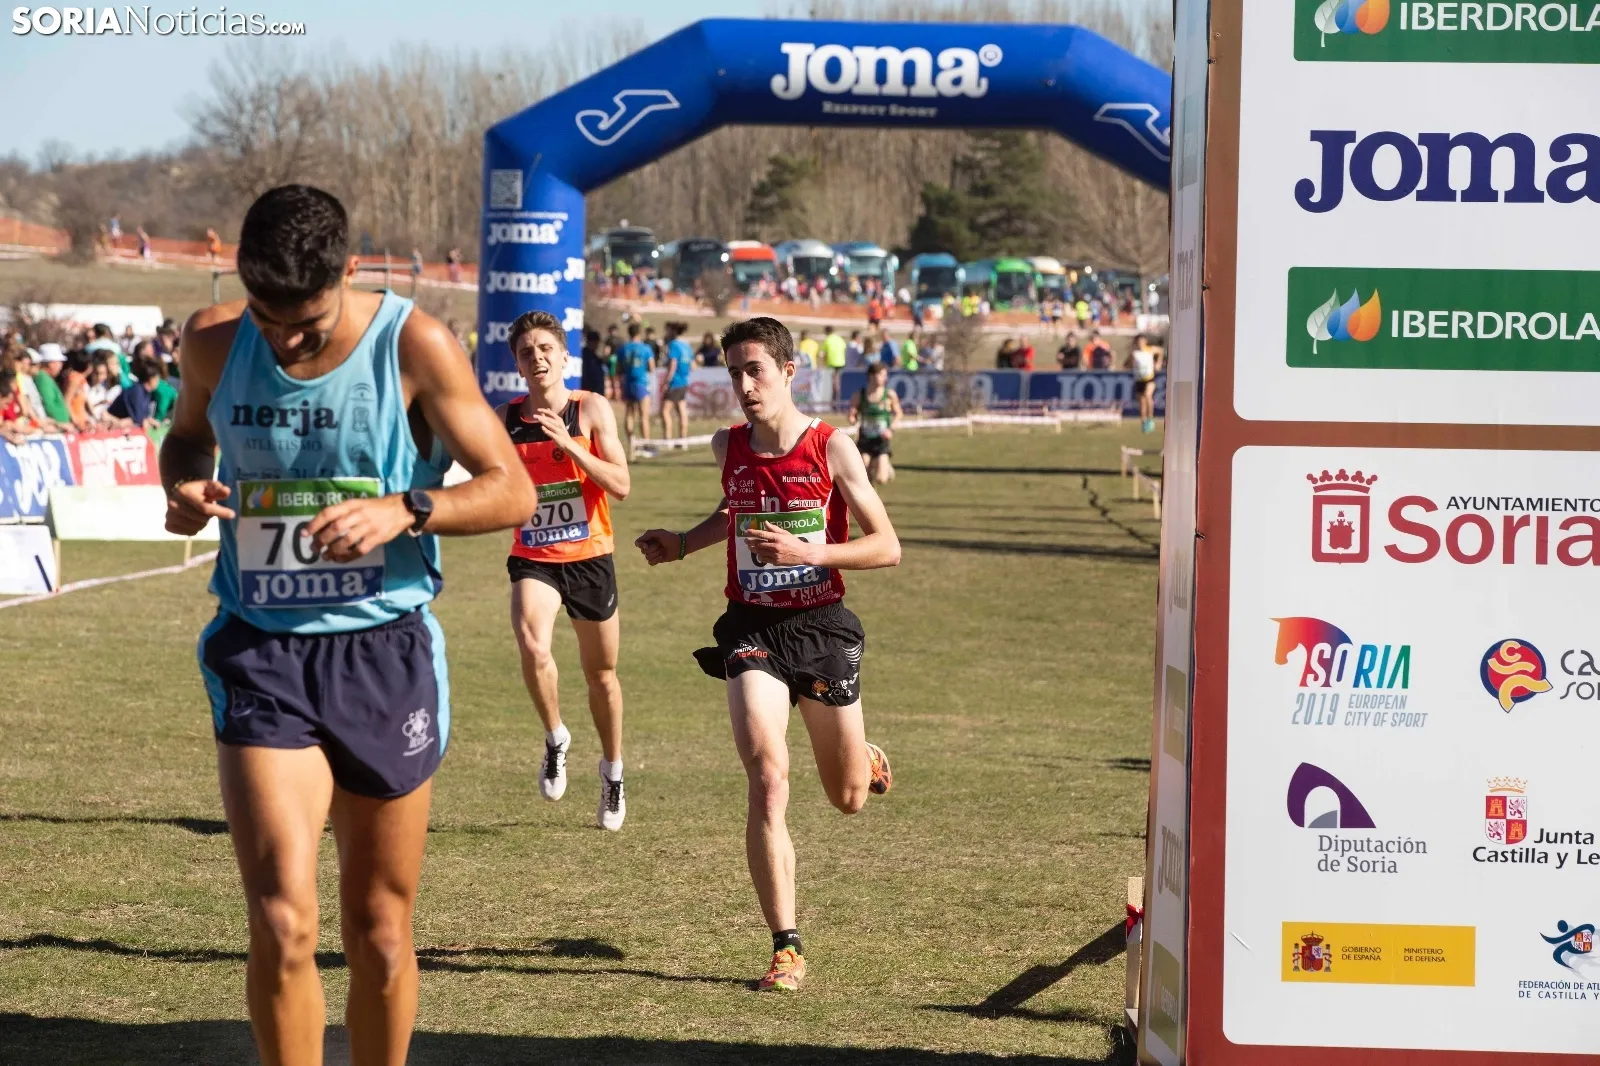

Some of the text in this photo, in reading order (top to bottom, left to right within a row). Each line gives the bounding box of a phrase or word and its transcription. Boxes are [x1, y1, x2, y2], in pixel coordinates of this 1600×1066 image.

[1399, 2, 1600, 32] IBERDROLA
[1391, 309, 1600, 341] IBERDROLA
[230, 400, 338, 436] nerja
[1446, 495, 1600, 513] AYUNTAMIENTO
[1383, 494, 1600, 567] Soria
[1306, 642, 1411, 689] SORIA
[1291, 692, 1340, 726] 2019
[1348, 693, 1408, 710] EUROPEAN
[1344, 711, 1428, 728] CITY OF SPORT
[1533, 827, 1595, 845] Junta
[1318, 834, 1428, 857] Diputación
[1317, 853, 1398, 873] de Soria
[1472, 846, 1600, 869] Castilla y Le
[1341, 946, 1382, 954] GOBIERNO
[1341, 953, 1382, 961] DE ESPAÑA
[1403, 947, 1444, 955] MINISTERIO
[1415, 955, 1446, 963] DEFENSA
[1518, 980, 1571, 990] FEDERACIÓN
[1573, 982, 1584, 990] DE
[1518, 990, 1600, 1000] DE CASTILLA Y
